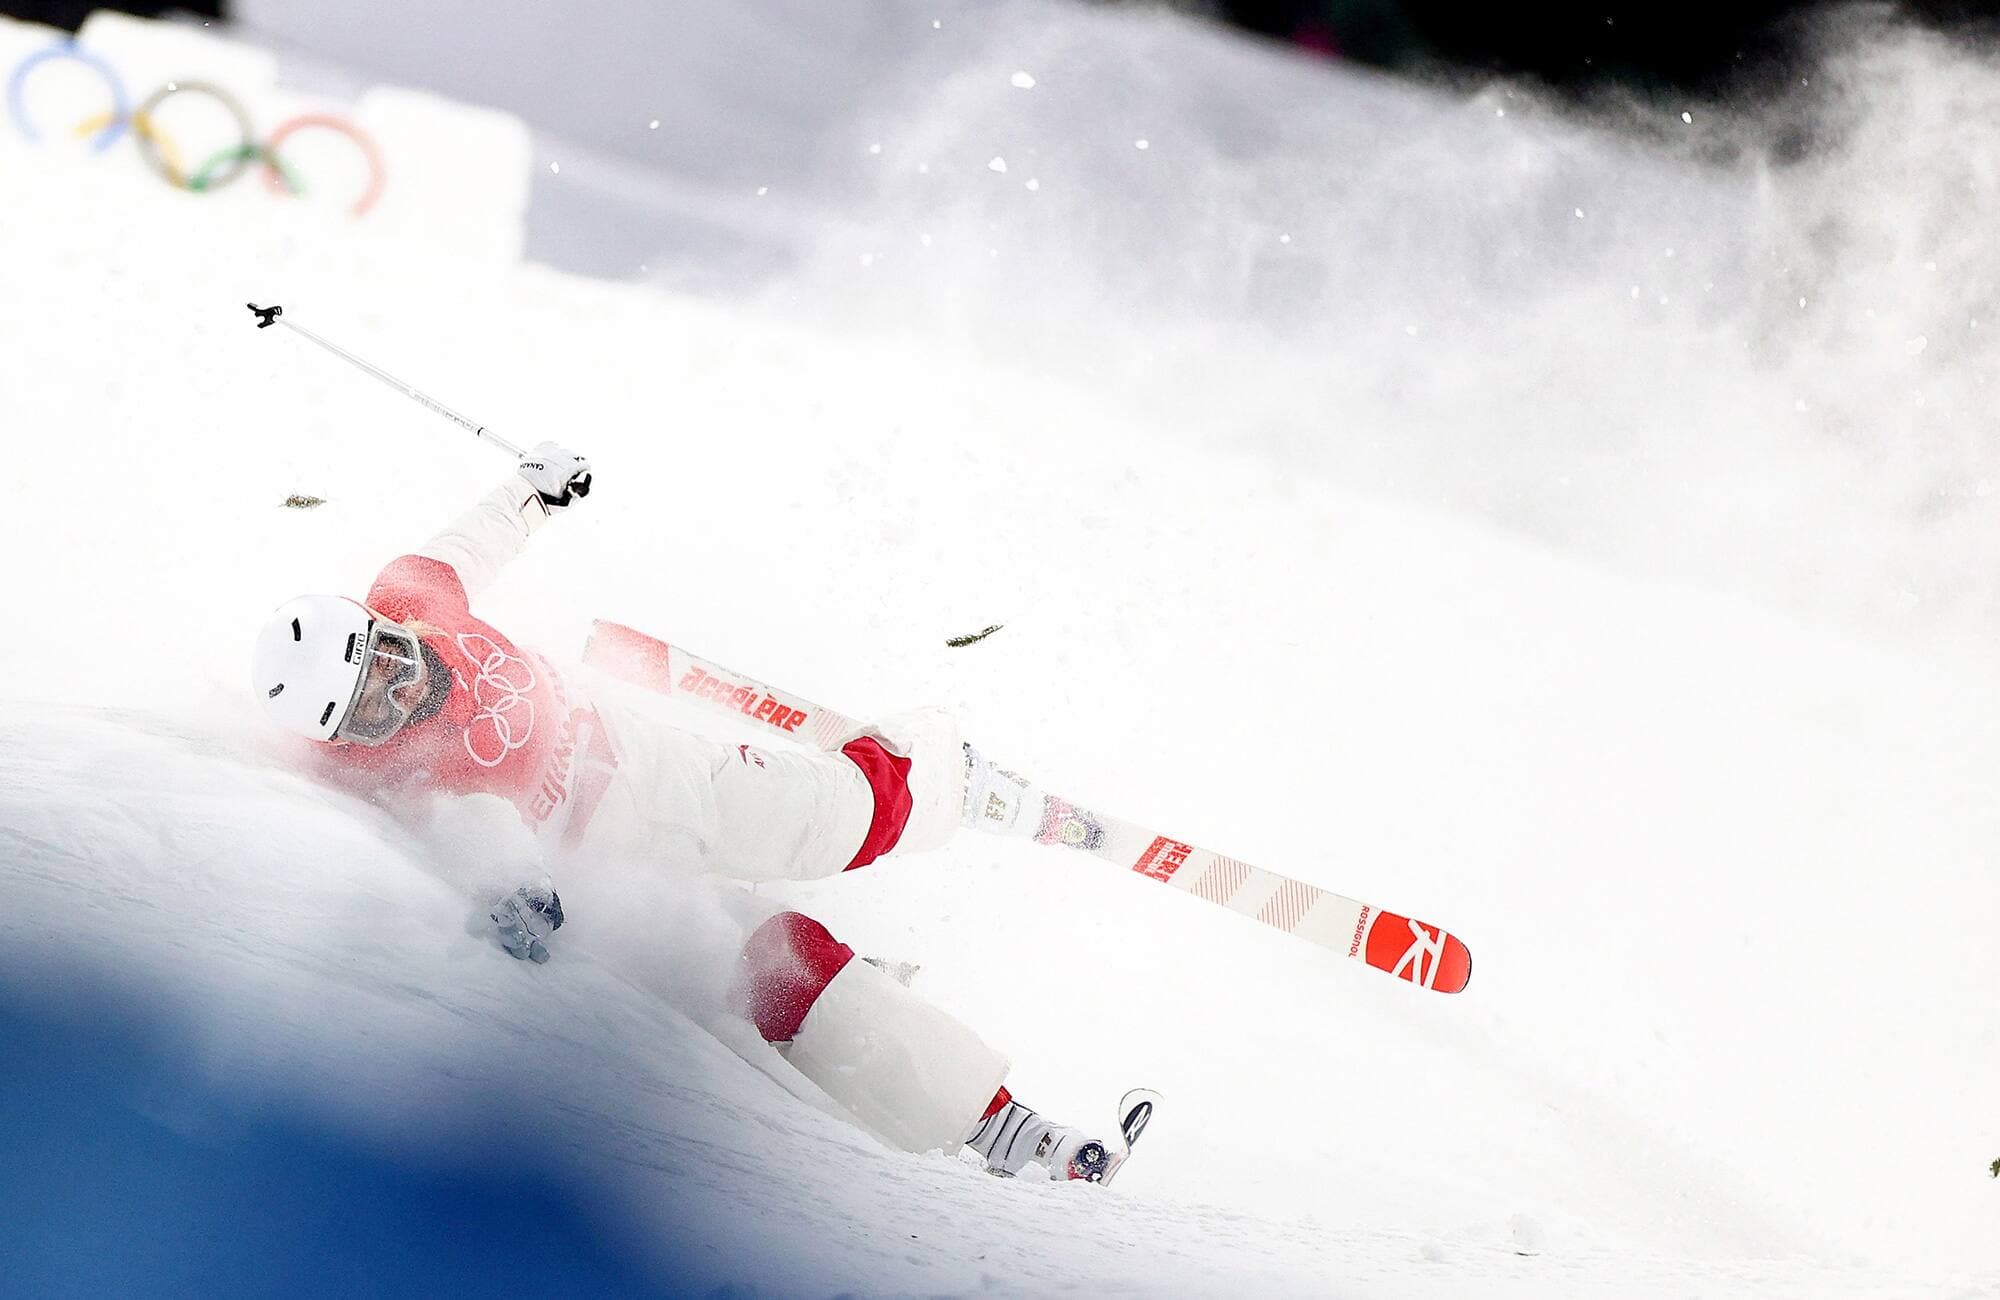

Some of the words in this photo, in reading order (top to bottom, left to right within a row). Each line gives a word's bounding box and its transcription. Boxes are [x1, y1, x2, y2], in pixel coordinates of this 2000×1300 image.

[353, 633, 366, 665] GIRO
[1347, 905, 1370, 958] ROSSIGNOL
[1035, 1131, 1052, 1158] FT
